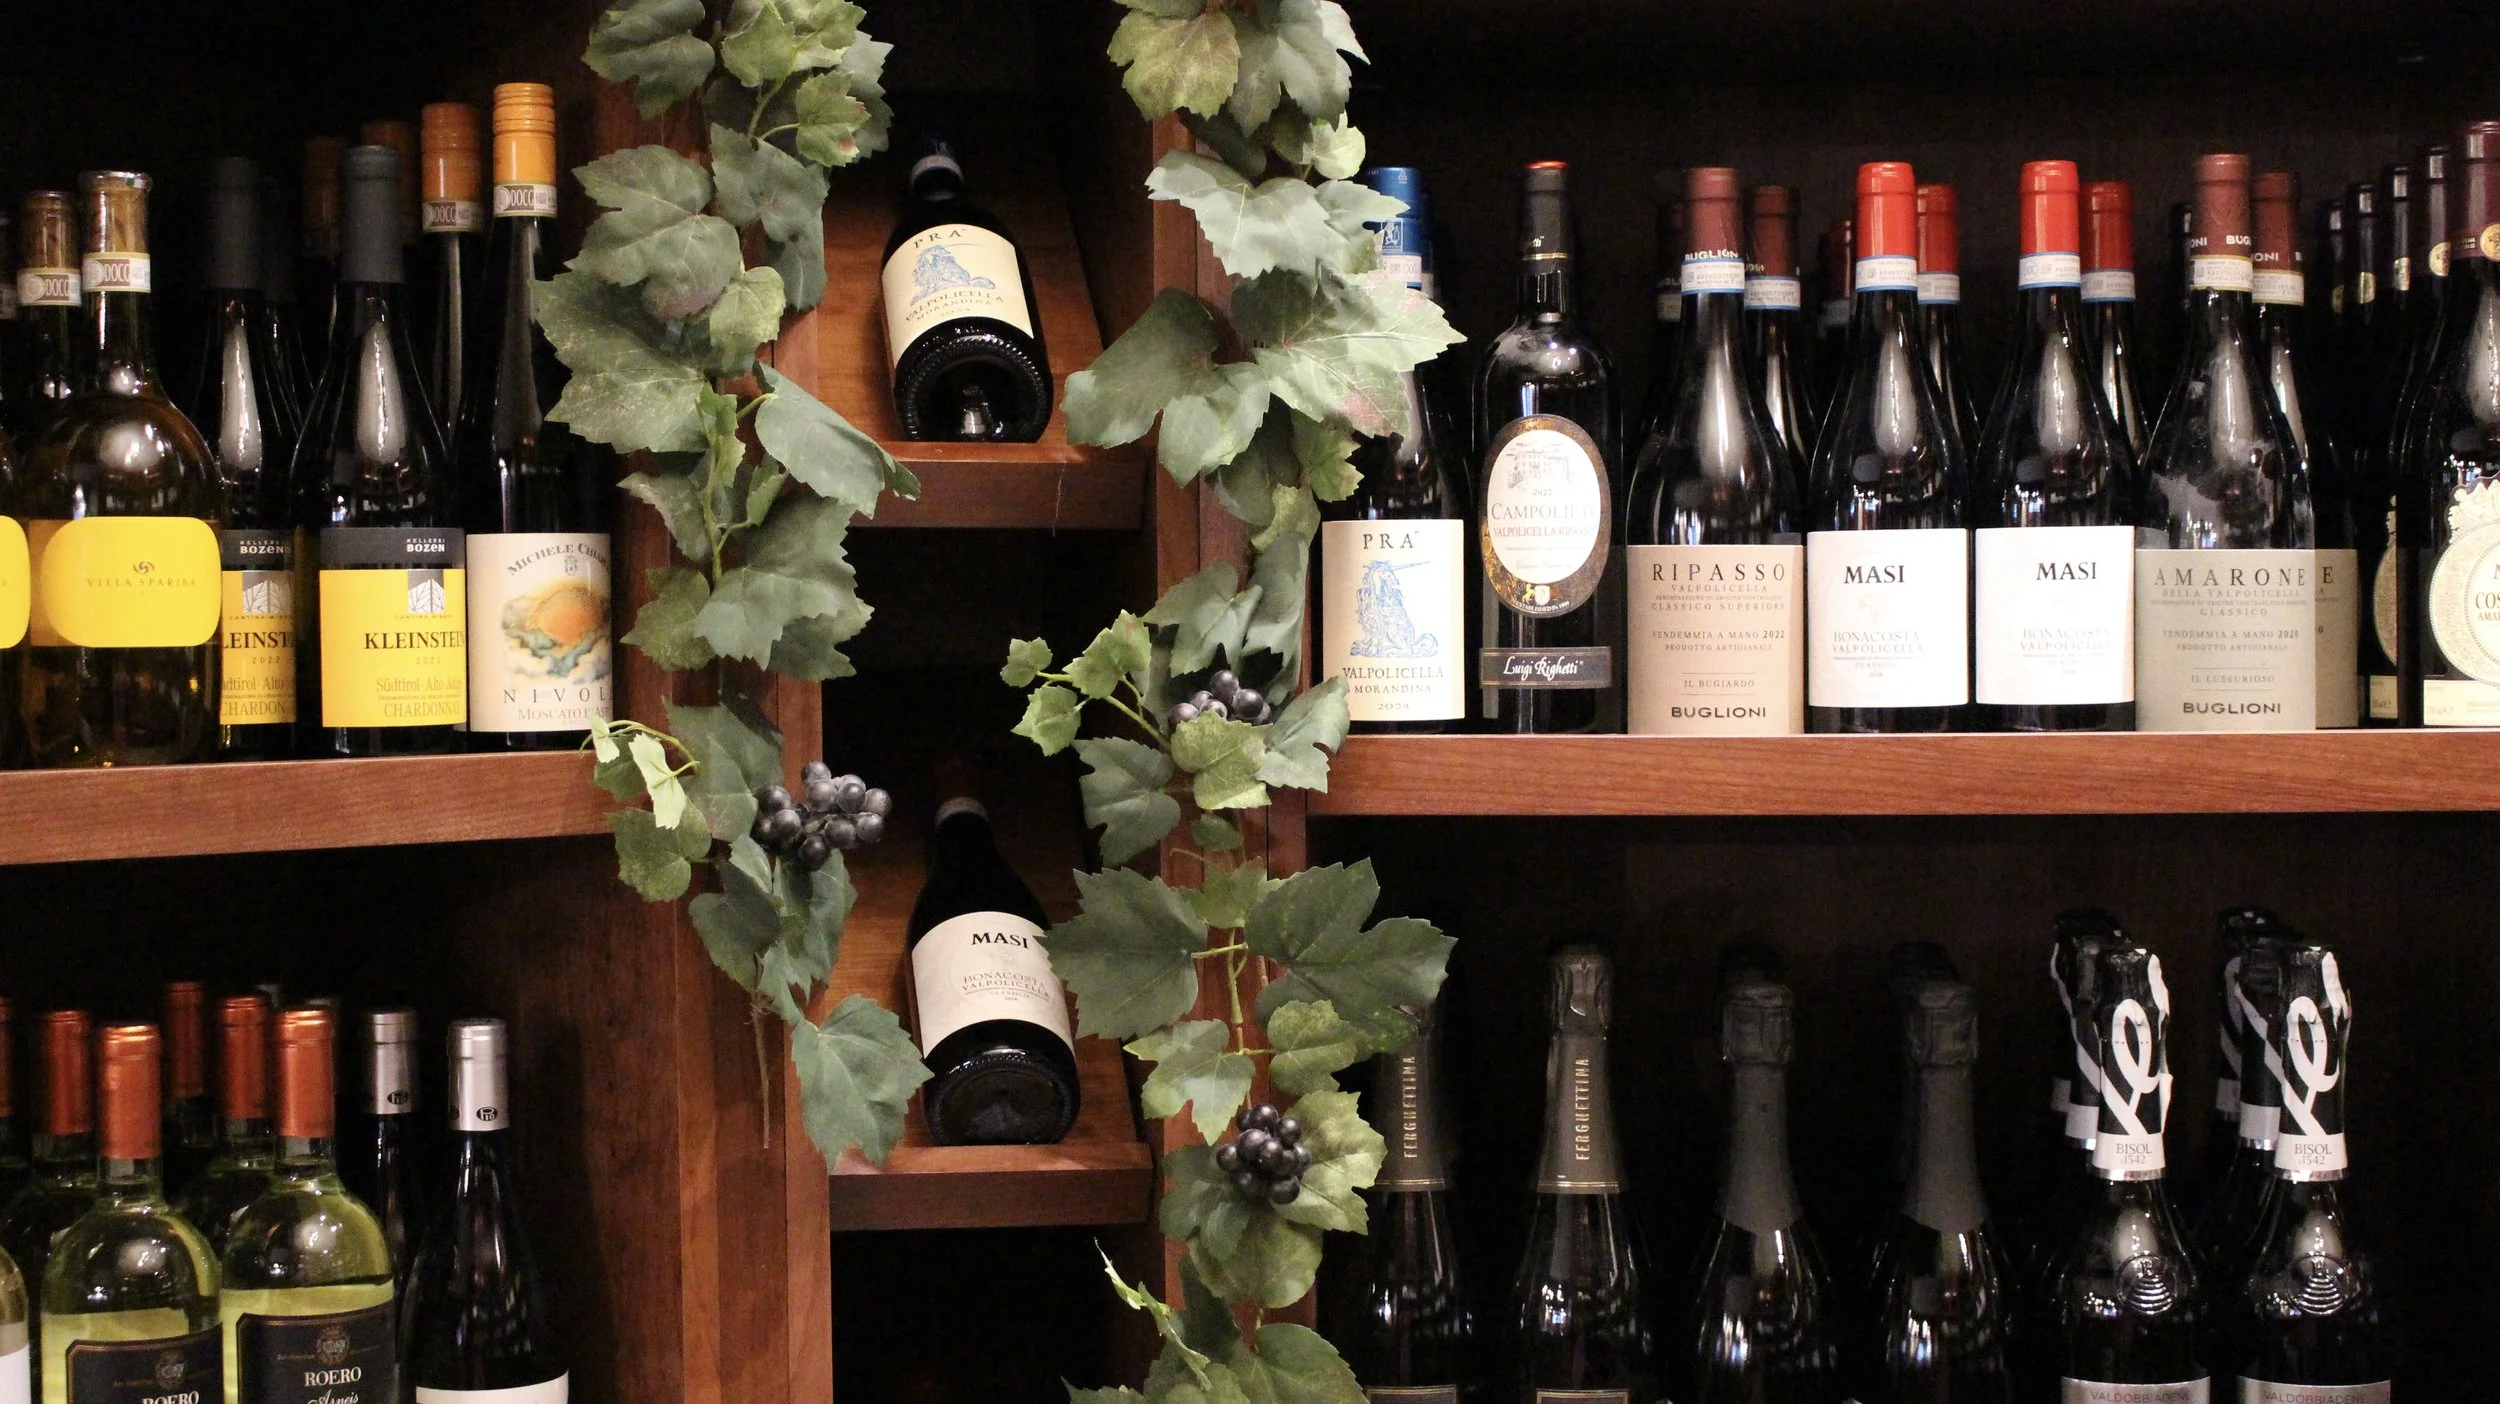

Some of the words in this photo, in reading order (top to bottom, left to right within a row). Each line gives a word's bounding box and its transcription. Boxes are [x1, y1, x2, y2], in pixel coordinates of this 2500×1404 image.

[507, 544, 574, 576] MICHELE
[1652, 563, 1785, 581] RIPASSO
[1844, 565, 1905, 584] MASI
[2037, 561, 2097, 581] MASI
[2154, 568, 2306, 586] AMARONE
[87, 578, 132, 587] VILLA
[139, 578, 197, 587] SPARINA
[1671, 584, 1768, 592] VALPOLICELLA
[2162, 588, 2201, 598] DELLA
[1651, 602, 1712, 611] CLASSICO
[1719, 602, 1785, 611] SUPERIORE
[2199, 608, 2268, 617] CLASSICO
[1651, 630, 1713, 640] VENDEMMIA
[1716, 631, 1725, 640] A
[1728, 631, 1760, 640] MANO
[1762, 629, 1785, 639] 2022
[1833, 631, 1920, 643] BONACOSTA
[2161, 629, 2228, 639] VENDEMMIA
[2242, 630, 2274, 639] MANO
[1664, 643, 1713, 652] PRODOTTO
[2176, 642, 2226, 652] PRODOTTO
[1342, 666, 1444, 679] VALPOLICELLA
[1503, 655, 1533, 681] Luigi
[1534, 656, 1578, 681] Righetti
[1354, 684, 1432, 694] MORANDINA
[1684, 679, 1695, 688] IL
[1698, 679, 1756, 689] BUGIARDO
[518, 708, 582, 721] MOSCATO
[1671, 706, 1767, 718] BUGLIONI
[2183, 703, 2281, 714] BUGLIONI
[970, 931, 1030, 950] MASI
[1402, 1056, 1418, 1158] FERGHETTINA
[1575, 1058, 1590, 1161] FERGHETTINA
[2116, 1143, 2153, 1155] BISOL
[2294, 1143, 2333, 1155] BISOL
[304, 1366, 362, 1387] ROERO
